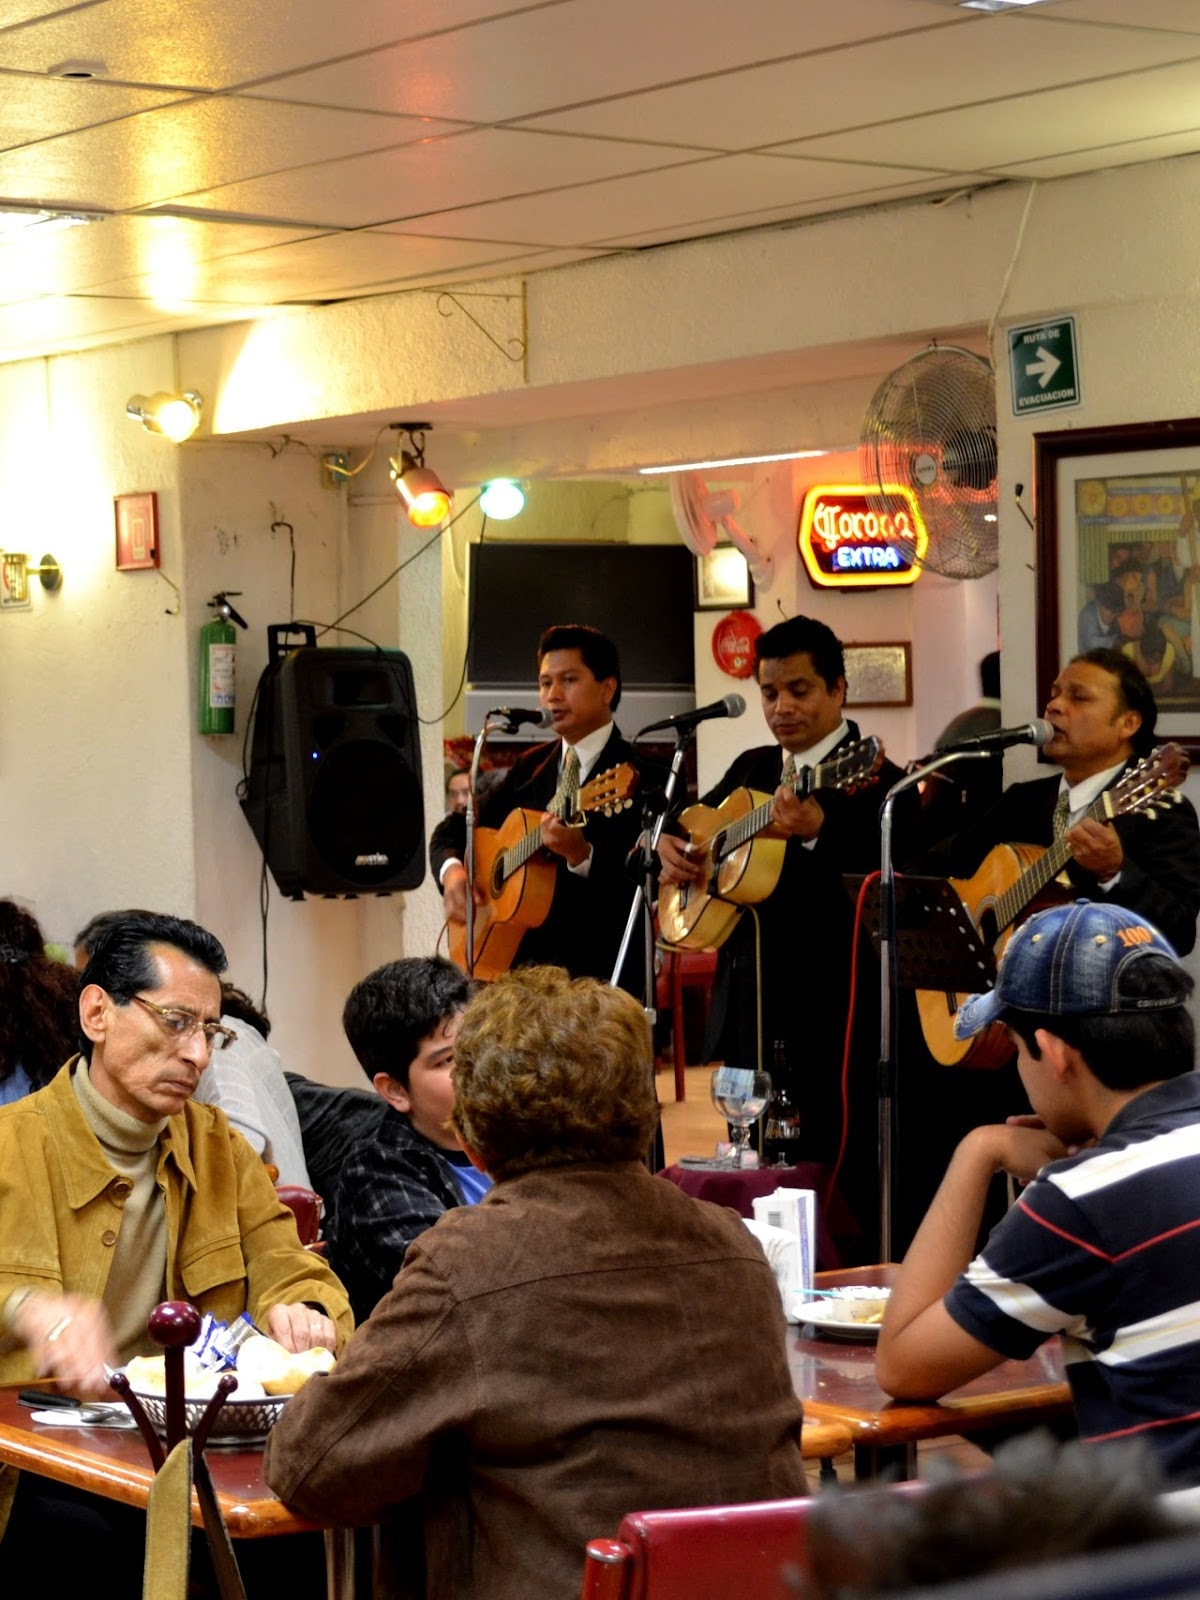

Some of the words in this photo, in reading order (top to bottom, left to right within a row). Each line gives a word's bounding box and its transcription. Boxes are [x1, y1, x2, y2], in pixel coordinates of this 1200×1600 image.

[1023, 331, 1047, 344] RUTA
[1048, 328, 1061, 339] DE
[1018, 388, 1075, 407] EVACUACION
[837, 546, 899, 568] EXTRA
[1116, 926, 1153, 948] 100
